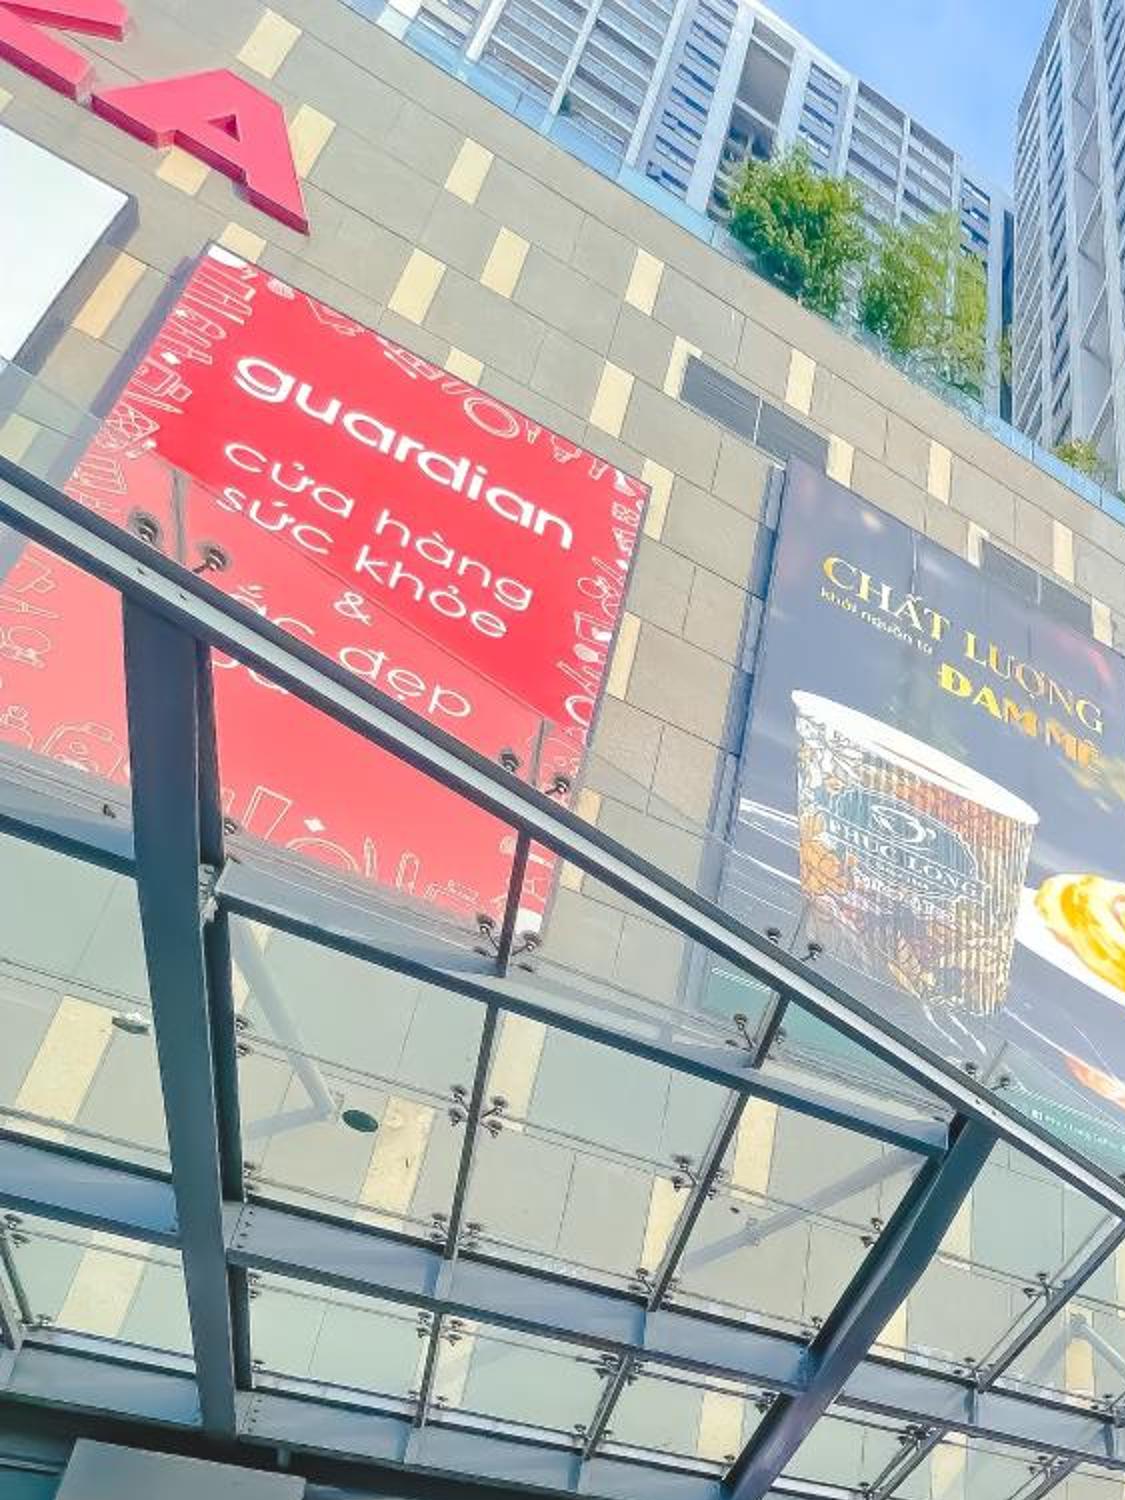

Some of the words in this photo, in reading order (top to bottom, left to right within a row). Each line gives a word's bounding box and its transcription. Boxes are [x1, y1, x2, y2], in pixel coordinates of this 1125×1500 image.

[224, 442, 354, 519] cửa
[375, 509, 533, 611] hàng
[234, 356, 573, 549] guardian
[216, 486, 334, 555] sức
[354, 545, 508, 637] khỏe
[333, 590, 373, 626] &
[339, 646, 472, 718] đẹp
[822, 555, 951, 641] CHẤT
[963, 631, 1104, 734] LƯỢNG
[938, 662, 1038, 737] ĐAM
